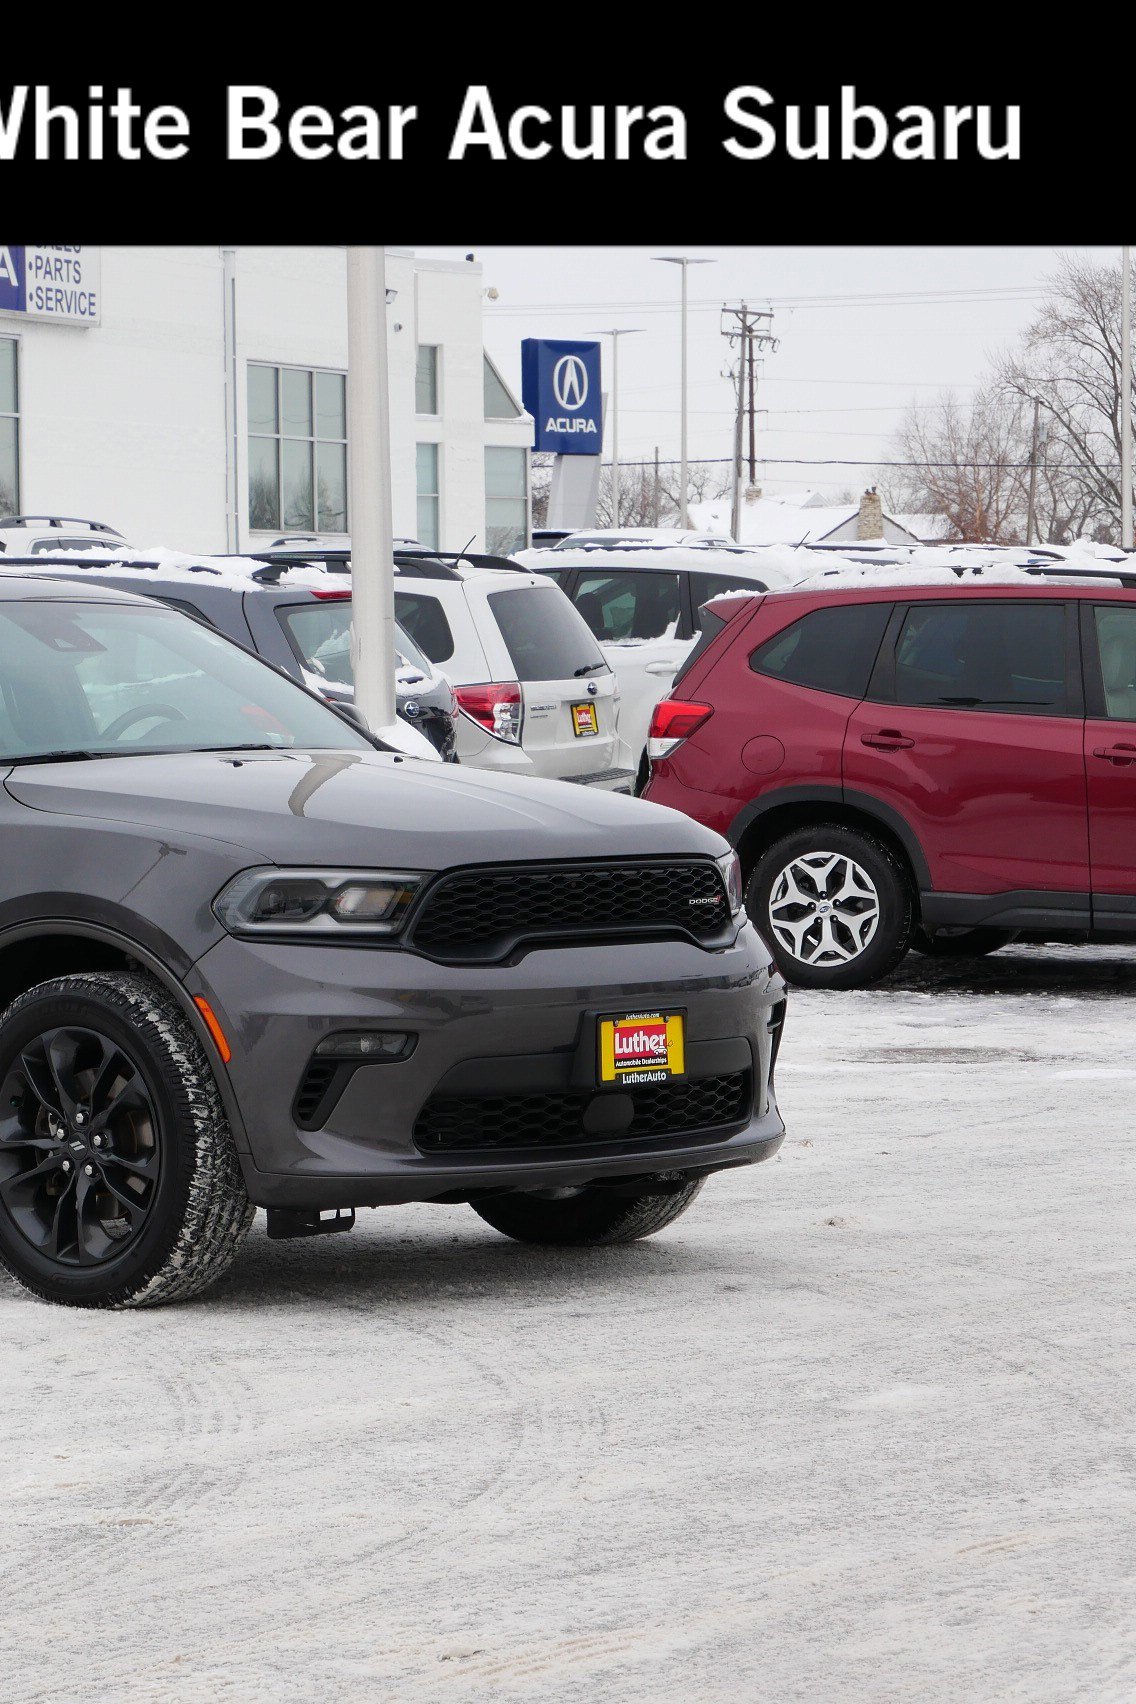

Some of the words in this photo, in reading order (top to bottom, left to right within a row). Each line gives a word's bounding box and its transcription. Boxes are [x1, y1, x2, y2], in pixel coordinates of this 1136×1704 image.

[545, 418, 597, 433] ACURA
[689, 897, 719, 905] DODGE
[614, 1030, 666, 1055] Luther
[615, 1059, 641, 1067] Automobile
[641, 1057, 667, 1065] Dealerships
[622, 1070, 667, 1084] LutherAuto
